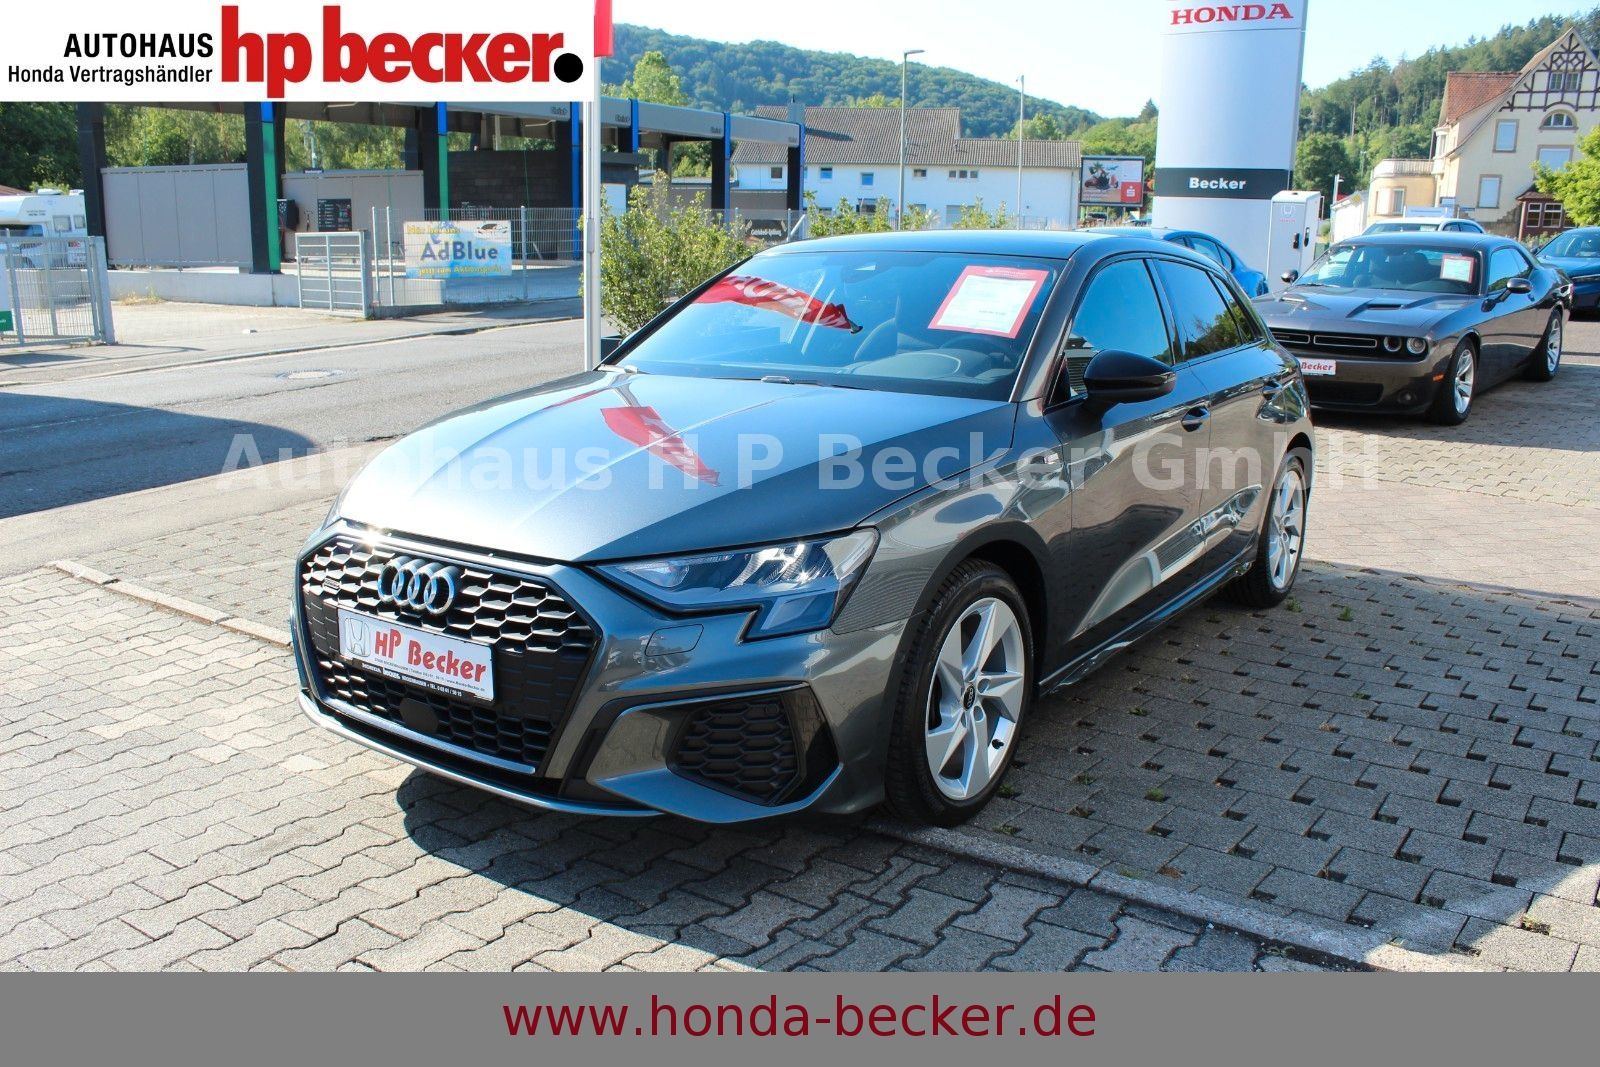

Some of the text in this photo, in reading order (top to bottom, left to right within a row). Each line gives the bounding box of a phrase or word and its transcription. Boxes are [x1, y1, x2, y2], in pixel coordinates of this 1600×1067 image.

[1170, 3, 1294, 25] HONDA
[1189, 177, 1247, 190] Becker
[421, 241, 498, 260] AdBlue
[1301, 361, 1333, 372] Becker
[375, 629, 401, 658] HP
[408, 640, 486, 682] Becker
